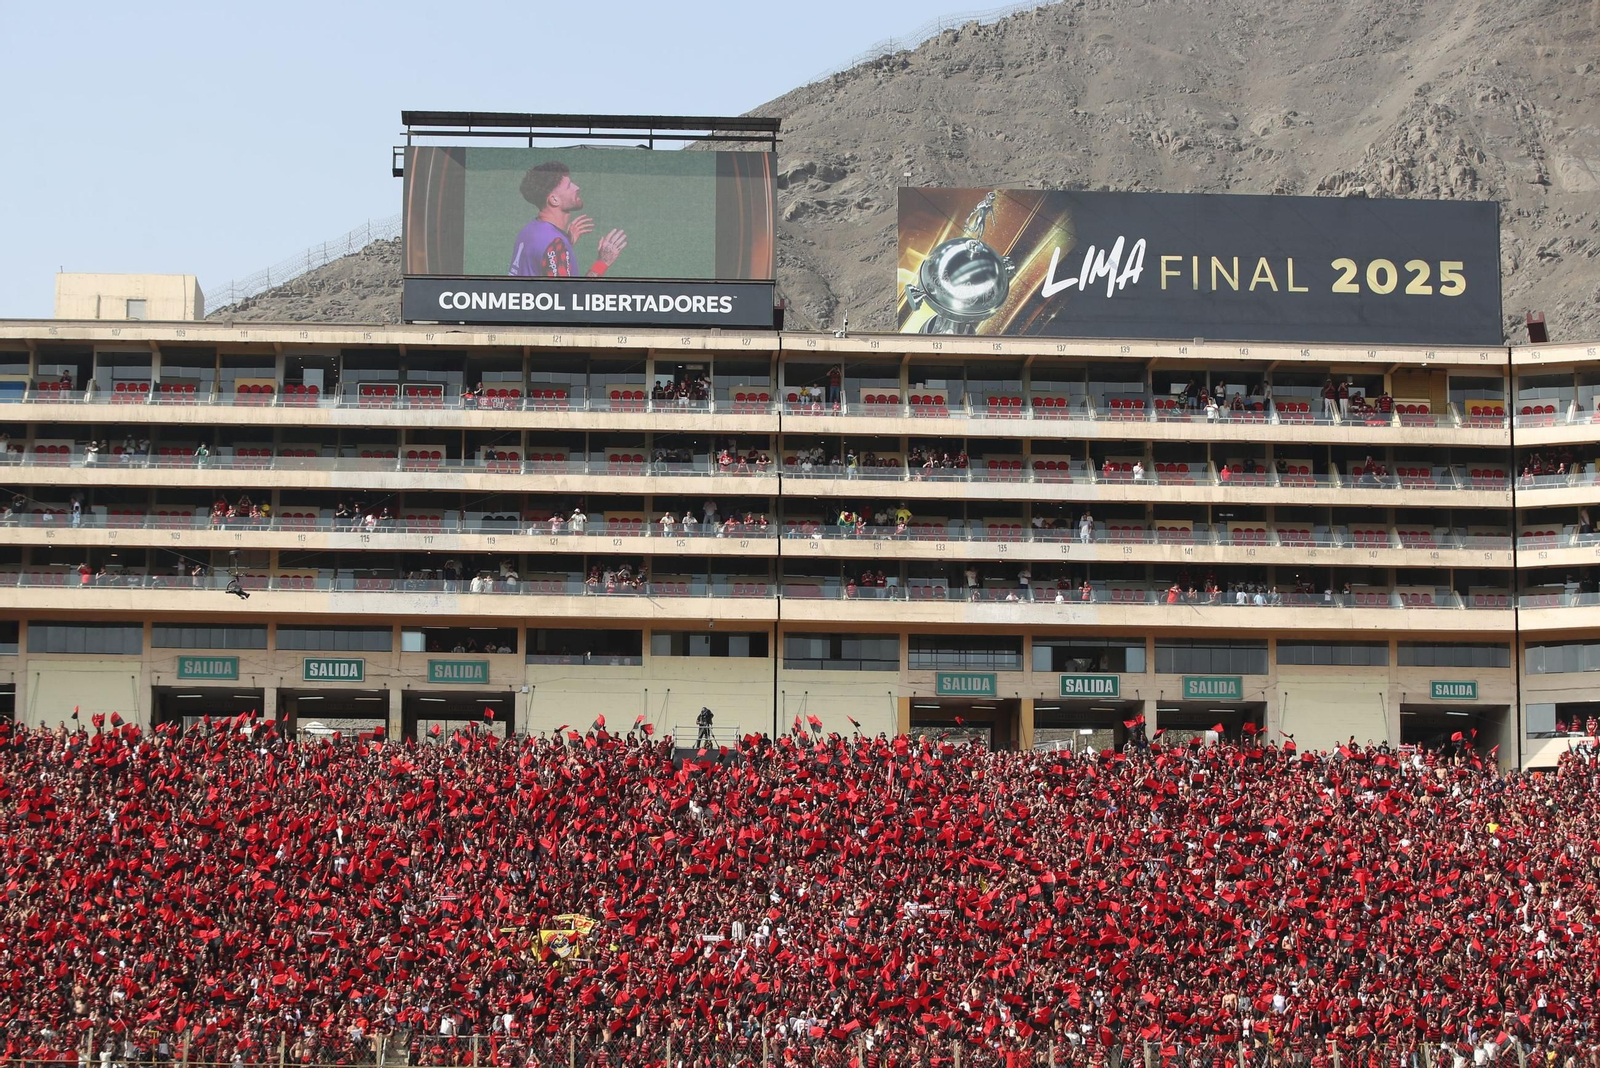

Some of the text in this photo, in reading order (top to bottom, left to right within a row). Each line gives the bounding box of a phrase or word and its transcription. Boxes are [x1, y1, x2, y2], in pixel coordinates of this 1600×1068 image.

[1041, 235, 1467, 298] LIMA FINAL 2025
[438, 290, 732, 313] CONMEBOL LIBERTADORES
[111, 328, 121, 336] 107
[240, 330, 249, 338] 111
[299, 331, 308, 339] 113
[363, 332, 372, 340] 115
[425, 333, 434, 341] 117
[552, 335, 562, 343] 121
[617, 336, 627, 344] 123
[681, 337, 691, 345] 125
[742, 338, 751, 346] 127
[806, 339, 816, 347] 129
[870, 340, 880, 348] 131
[932, 341, 942, 350] 133
[992, 343, 1002, 351] 135
[1056, 344, 1066, 352] 137
[1178, 347, 1188, 355] 141
[1239, 348, 1249, 356] 143
[1300, 349, 1310, 357] 145
[1367, 351, 1377, 359] 147
[1479, 352, 1489, 360] 151
[1531, 351, 1541, 359] 153
[1586, 348, 1597, 356] 155
[108, 531, 118, 539] 107
[234, 533, 242, 541] 111
[297, 534, 306, 542] 113
[360, 535, 370, 543] 115
[424, 536, 434, 544] 117
[550, 538, 559, 546] 121
[612, 538, 622, 546] 123
[676, 539, 686, 547] 125
[740, 540, 749, 548] 127
[873, 542, 882, 550] 131
[935, 543, 946, 551] 133
[997, 544, 1007, 552] 135
[1060, 545, 1070, 553] 137
[1122, 546, 1132, 554] 139
[1184, 547, 1193, 555] 141
[1245, 548, 1256, 556] 143
[1368, 551, 1378, 559] 147
[1538, 551, 1548, 559] 153
[1483, 552, 1493, 560] 151
[184, 660, 233, 675] SALIDA
[309, 662, 358, 677] SALIDA
[434, 664, 483, 679] SALIDA
[942, 677, 990, 692] SALIDA
[1065, 679, 1114, 694] SALIDA
[1189, 680, 1237, 695] SALIDA
[1435, 684, 1473, 696] SALIDA
